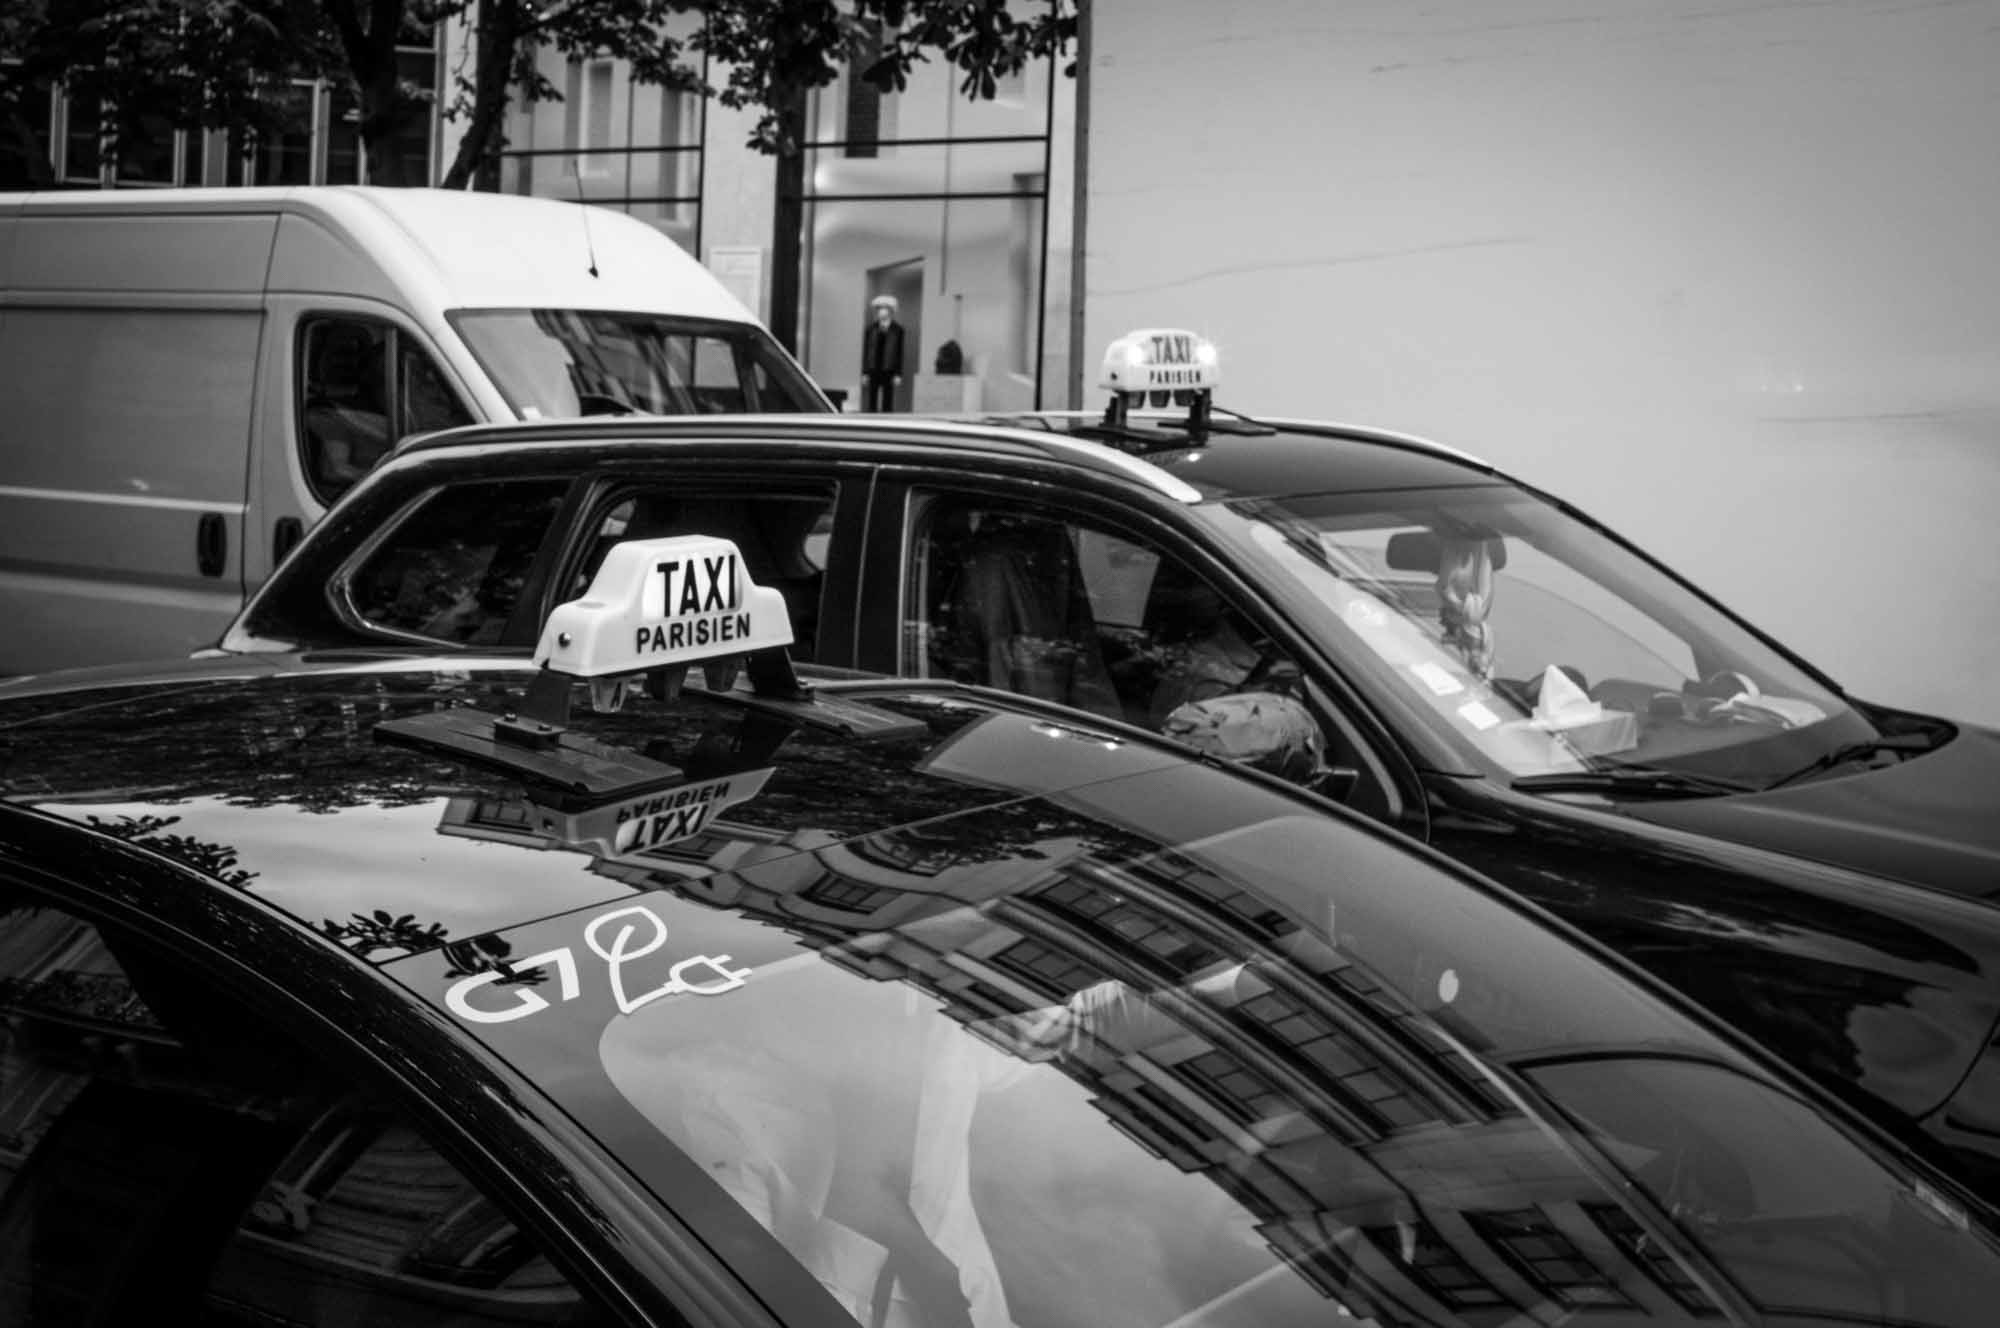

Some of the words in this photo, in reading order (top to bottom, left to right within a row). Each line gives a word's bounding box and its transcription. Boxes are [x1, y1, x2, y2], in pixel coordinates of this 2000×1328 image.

[1151, 335, 1190, 364] TAXI
[1149, 370, 1201, 384] PARISIEN
[657, 554, 736, 617] TAXI
[636, 612, 750, 654] PARISIEN
[445, 947, 580, 1023] G7
